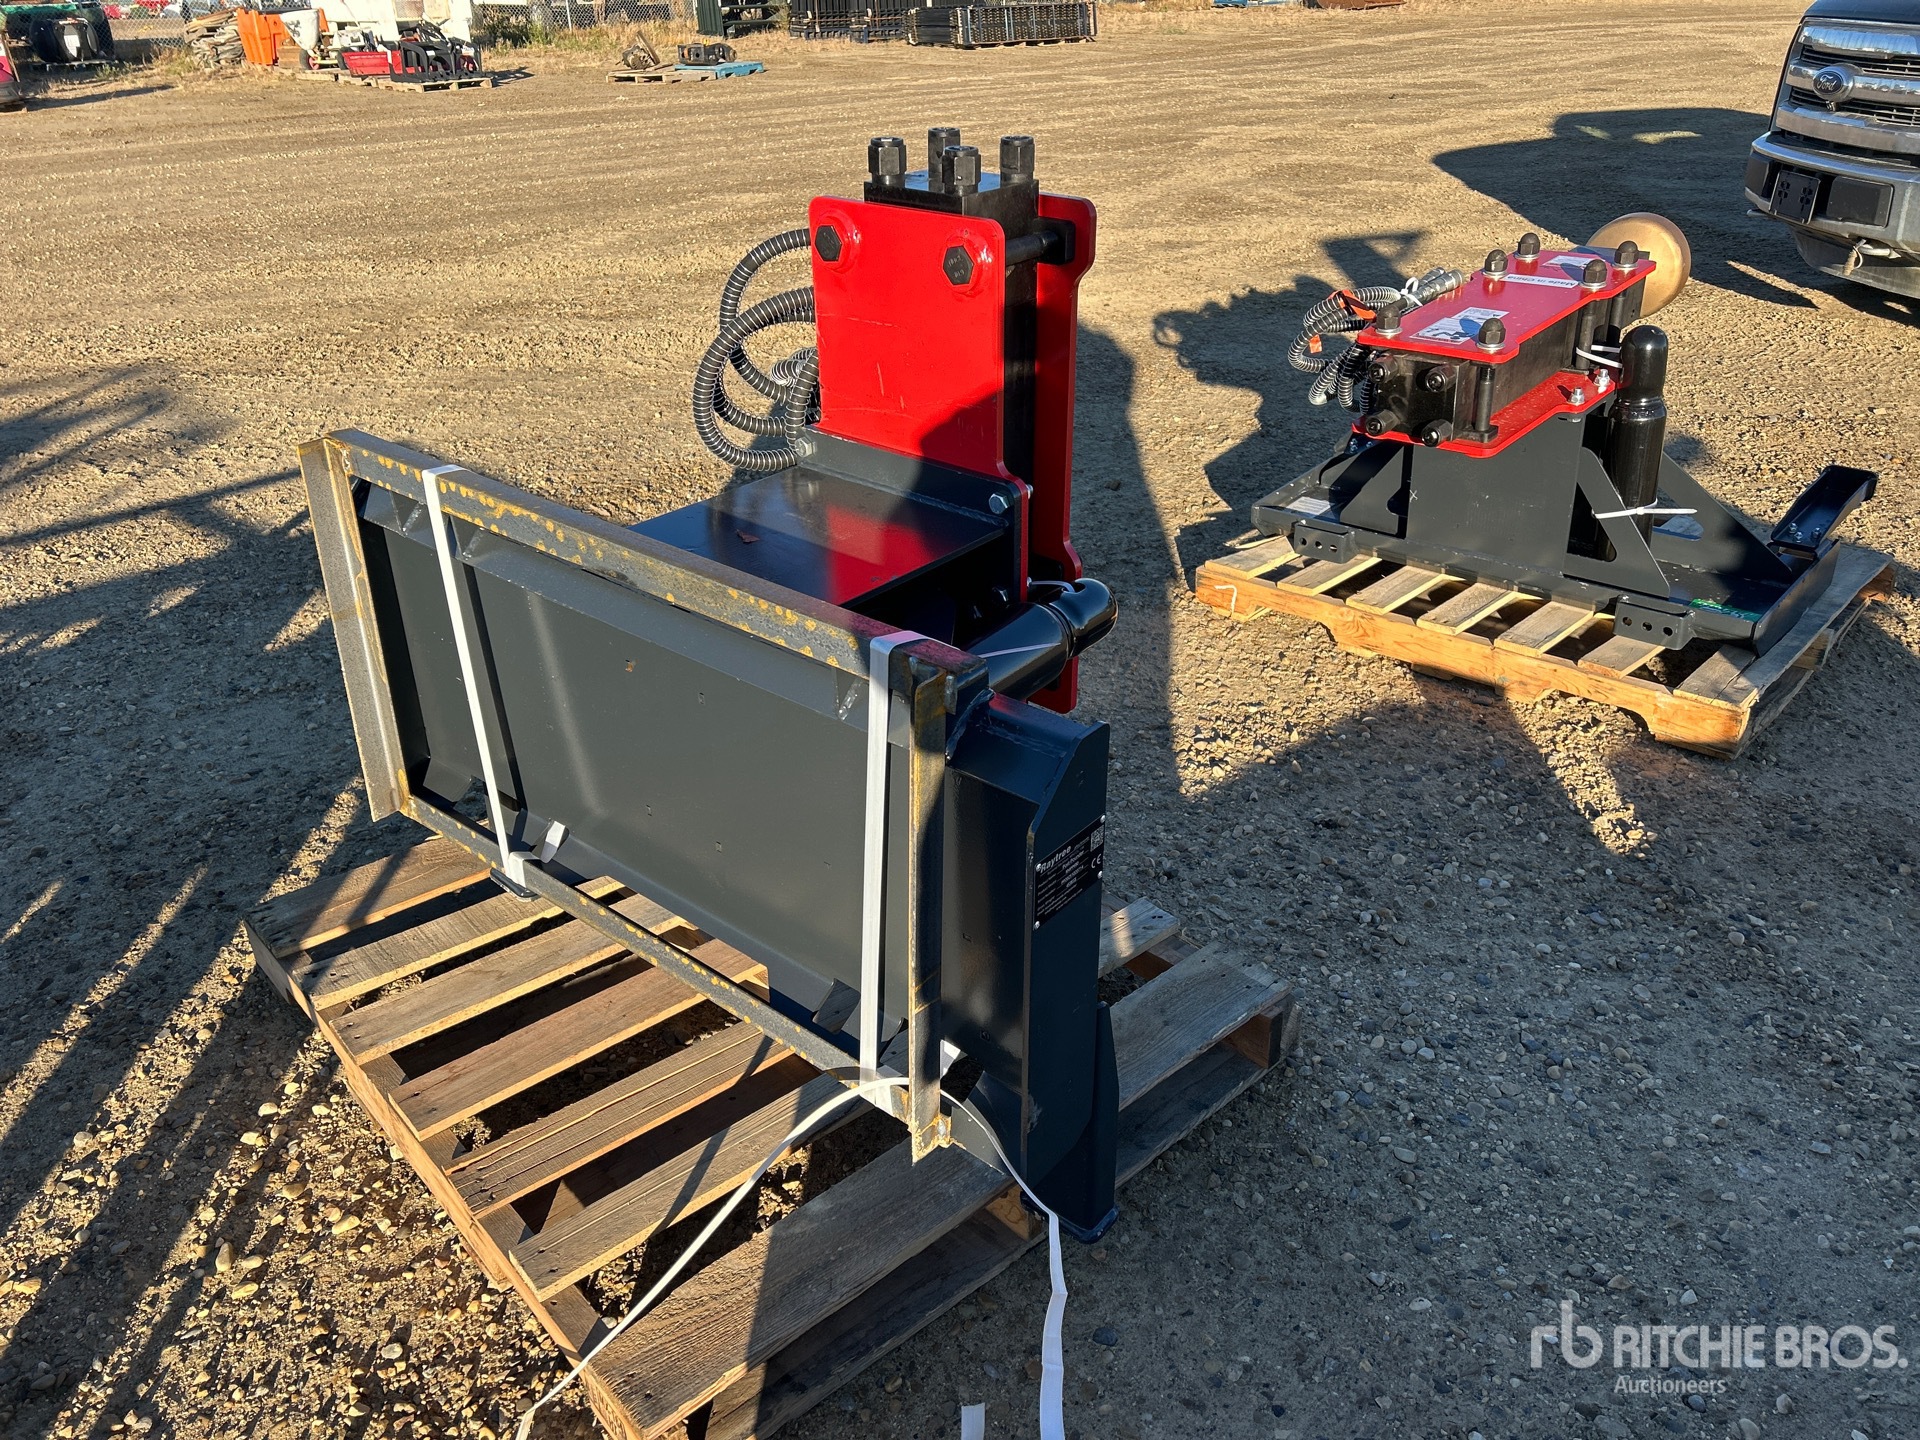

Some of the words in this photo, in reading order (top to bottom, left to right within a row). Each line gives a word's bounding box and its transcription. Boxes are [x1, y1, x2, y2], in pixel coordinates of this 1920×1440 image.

[1816, 74, 1837, 91] Ford
[1507, 275, 1535, 283] China
[1040, 845, 1072, 873] Raytree
[1091, 853, 1102, 869] CE
